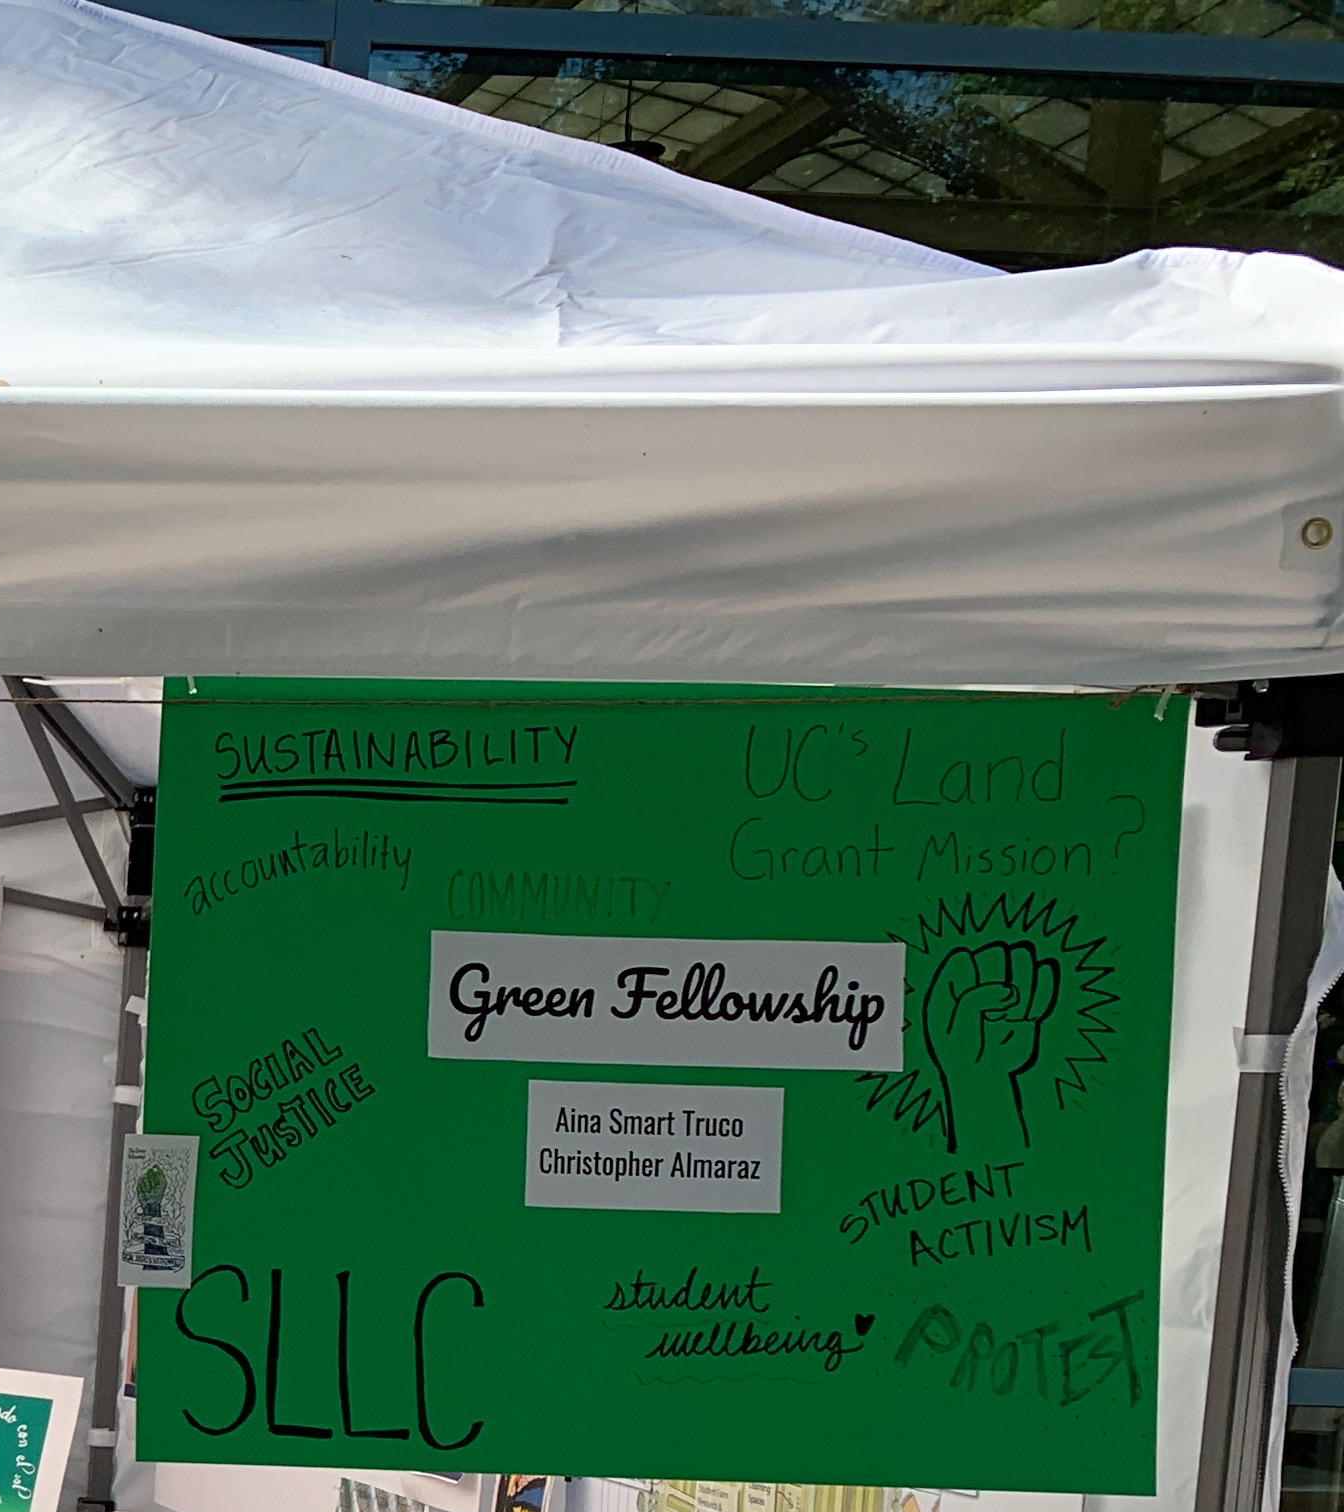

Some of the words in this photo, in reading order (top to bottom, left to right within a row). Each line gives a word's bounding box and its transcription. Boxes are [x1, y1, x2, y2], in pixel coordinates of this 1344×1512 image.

[215, 724, 578, 780] SUSTAINABILITY
[745, 723, 869, 802] UC's
[892, 726, 1067, 806] Land
[183, 827, 413, 915] accountability
[730, 816, 895, 881] Grant
[917, 794, 1146, 883] Mission?
[447, 868, 672, 923] COMMUNITY
[448, 961, 597, 1042] Green
[610, 960, 886, 1051] Fellowship
[192, 1027, 343, 1133] SOCIAL
[209, 1063, 377, 1189] JUSTICE
[555, 1106, 602, 1135] Aina
[609, 1108, 676, 1137] Smart
[682, 1110, 745, 1139] Truco
[538, 1146, 665, 1183] Christopher
[670, 1151, 762, 1181] Almaraz
[838, 1161, 1025, 1244] STUDENT
[909, 1204, 1092, 1267] ACTIVISM
[604, 1265, 774, 1314] student
[175, 1263, 486, 1452] SLLC
[644, 1319, 863, 1372] wellbeing
[893, 1289, 1146, 1408] PROTEST
